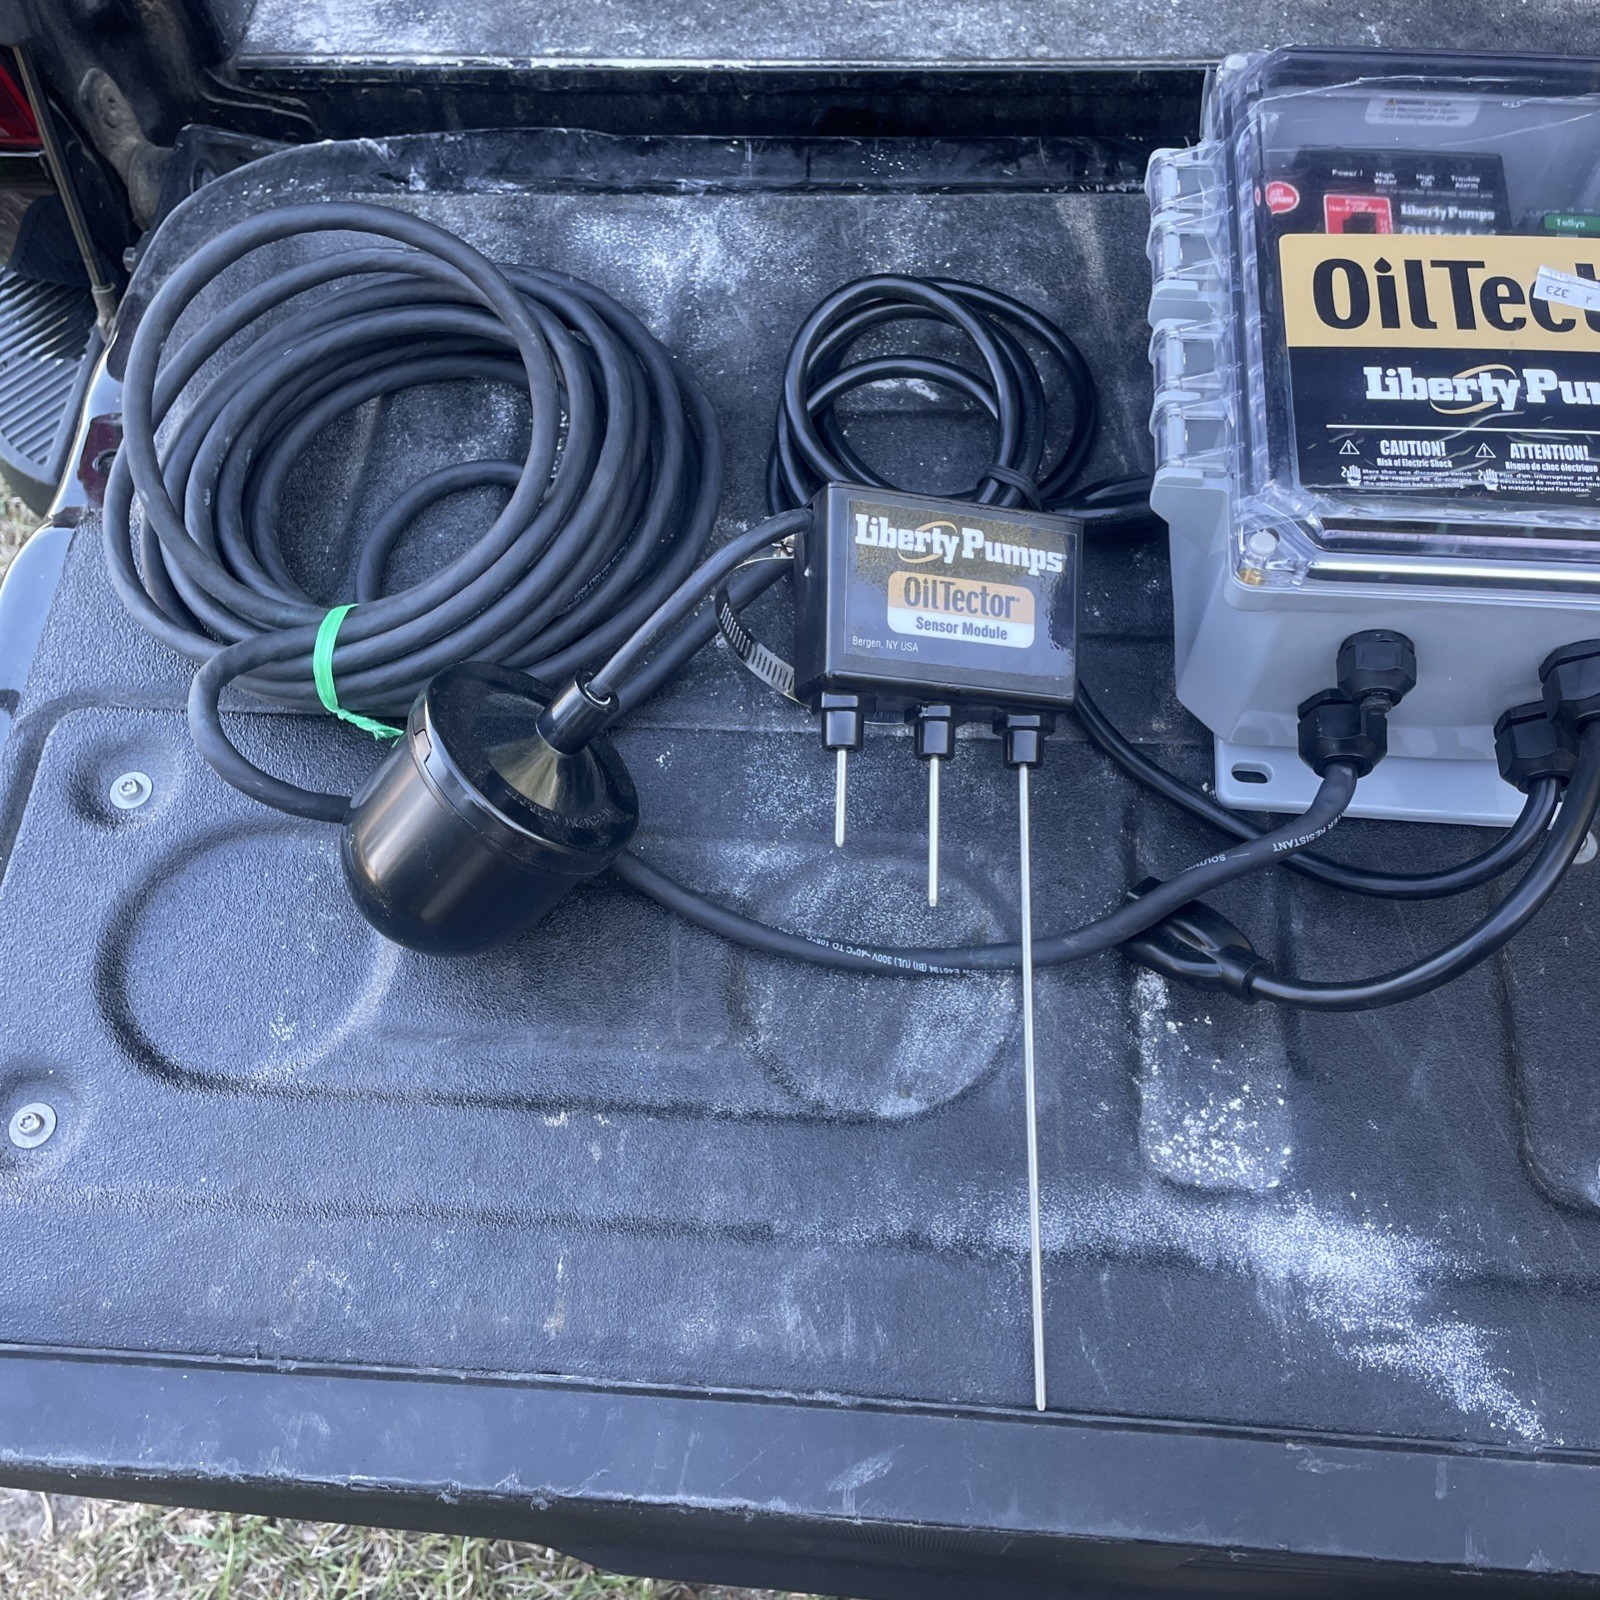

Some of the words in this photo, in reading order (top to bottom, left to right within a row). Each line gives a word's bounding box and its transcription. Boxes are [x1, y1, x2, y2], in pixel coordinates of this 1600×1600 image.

[1331, 168, 1358, 178] Power
[1375, 171, 1396, 181] High
[1415, 173, 1435, 182] High
[1450, 174, 1481, 183] Trouble
[1373, 177, 1398, 185] Water
[1455, 182, 1479, 190] Alarm
[1401, 203, 1447, 221] Liberty
[1447, 206, 1496, 222] Pumps
[1545, 285, 1570, 299] 323
[1362, 366, 1521, 411] Liberty
[1522, 368, 1600, 405] Pu
[1380, 440, 1447, 457] CAUTION!
[1510, 443, 1590, 461] ATTENTION!
[1376, 458, 1393, 467] Risk
[1394, 458, 1401, 467] of
[1402, 458, 1429, 468] Electric
[1430, 459, 1453, 468] Shock
[1505, 461, 1531, 471] Risque
[1531, 462, 1541, 471] de
[1541, 462, 1560, 471] choc
[1560, 462, 1598, 473] électrique
[1533, 473, 1575, 481] interrupteur
[855, 513, 960, 564] Liberty
[962, 527, 1064, 577] Pumps
[904, 576, 1017, 619] OilTector
[916, 616, 959, 635] Sensor
[962, 621, 1008, 641] Module
[852, 635, 884, 649] Bergen,
[886, 639, 899, 650] NY
[900, 641, 919, 652] USA
[1272, 828, 1327, 852] RESISTANT
[832, 941, 845, 953] TO
[872, 952, 893, 965] 300V
[894, 956, 911, 969] (UL)
